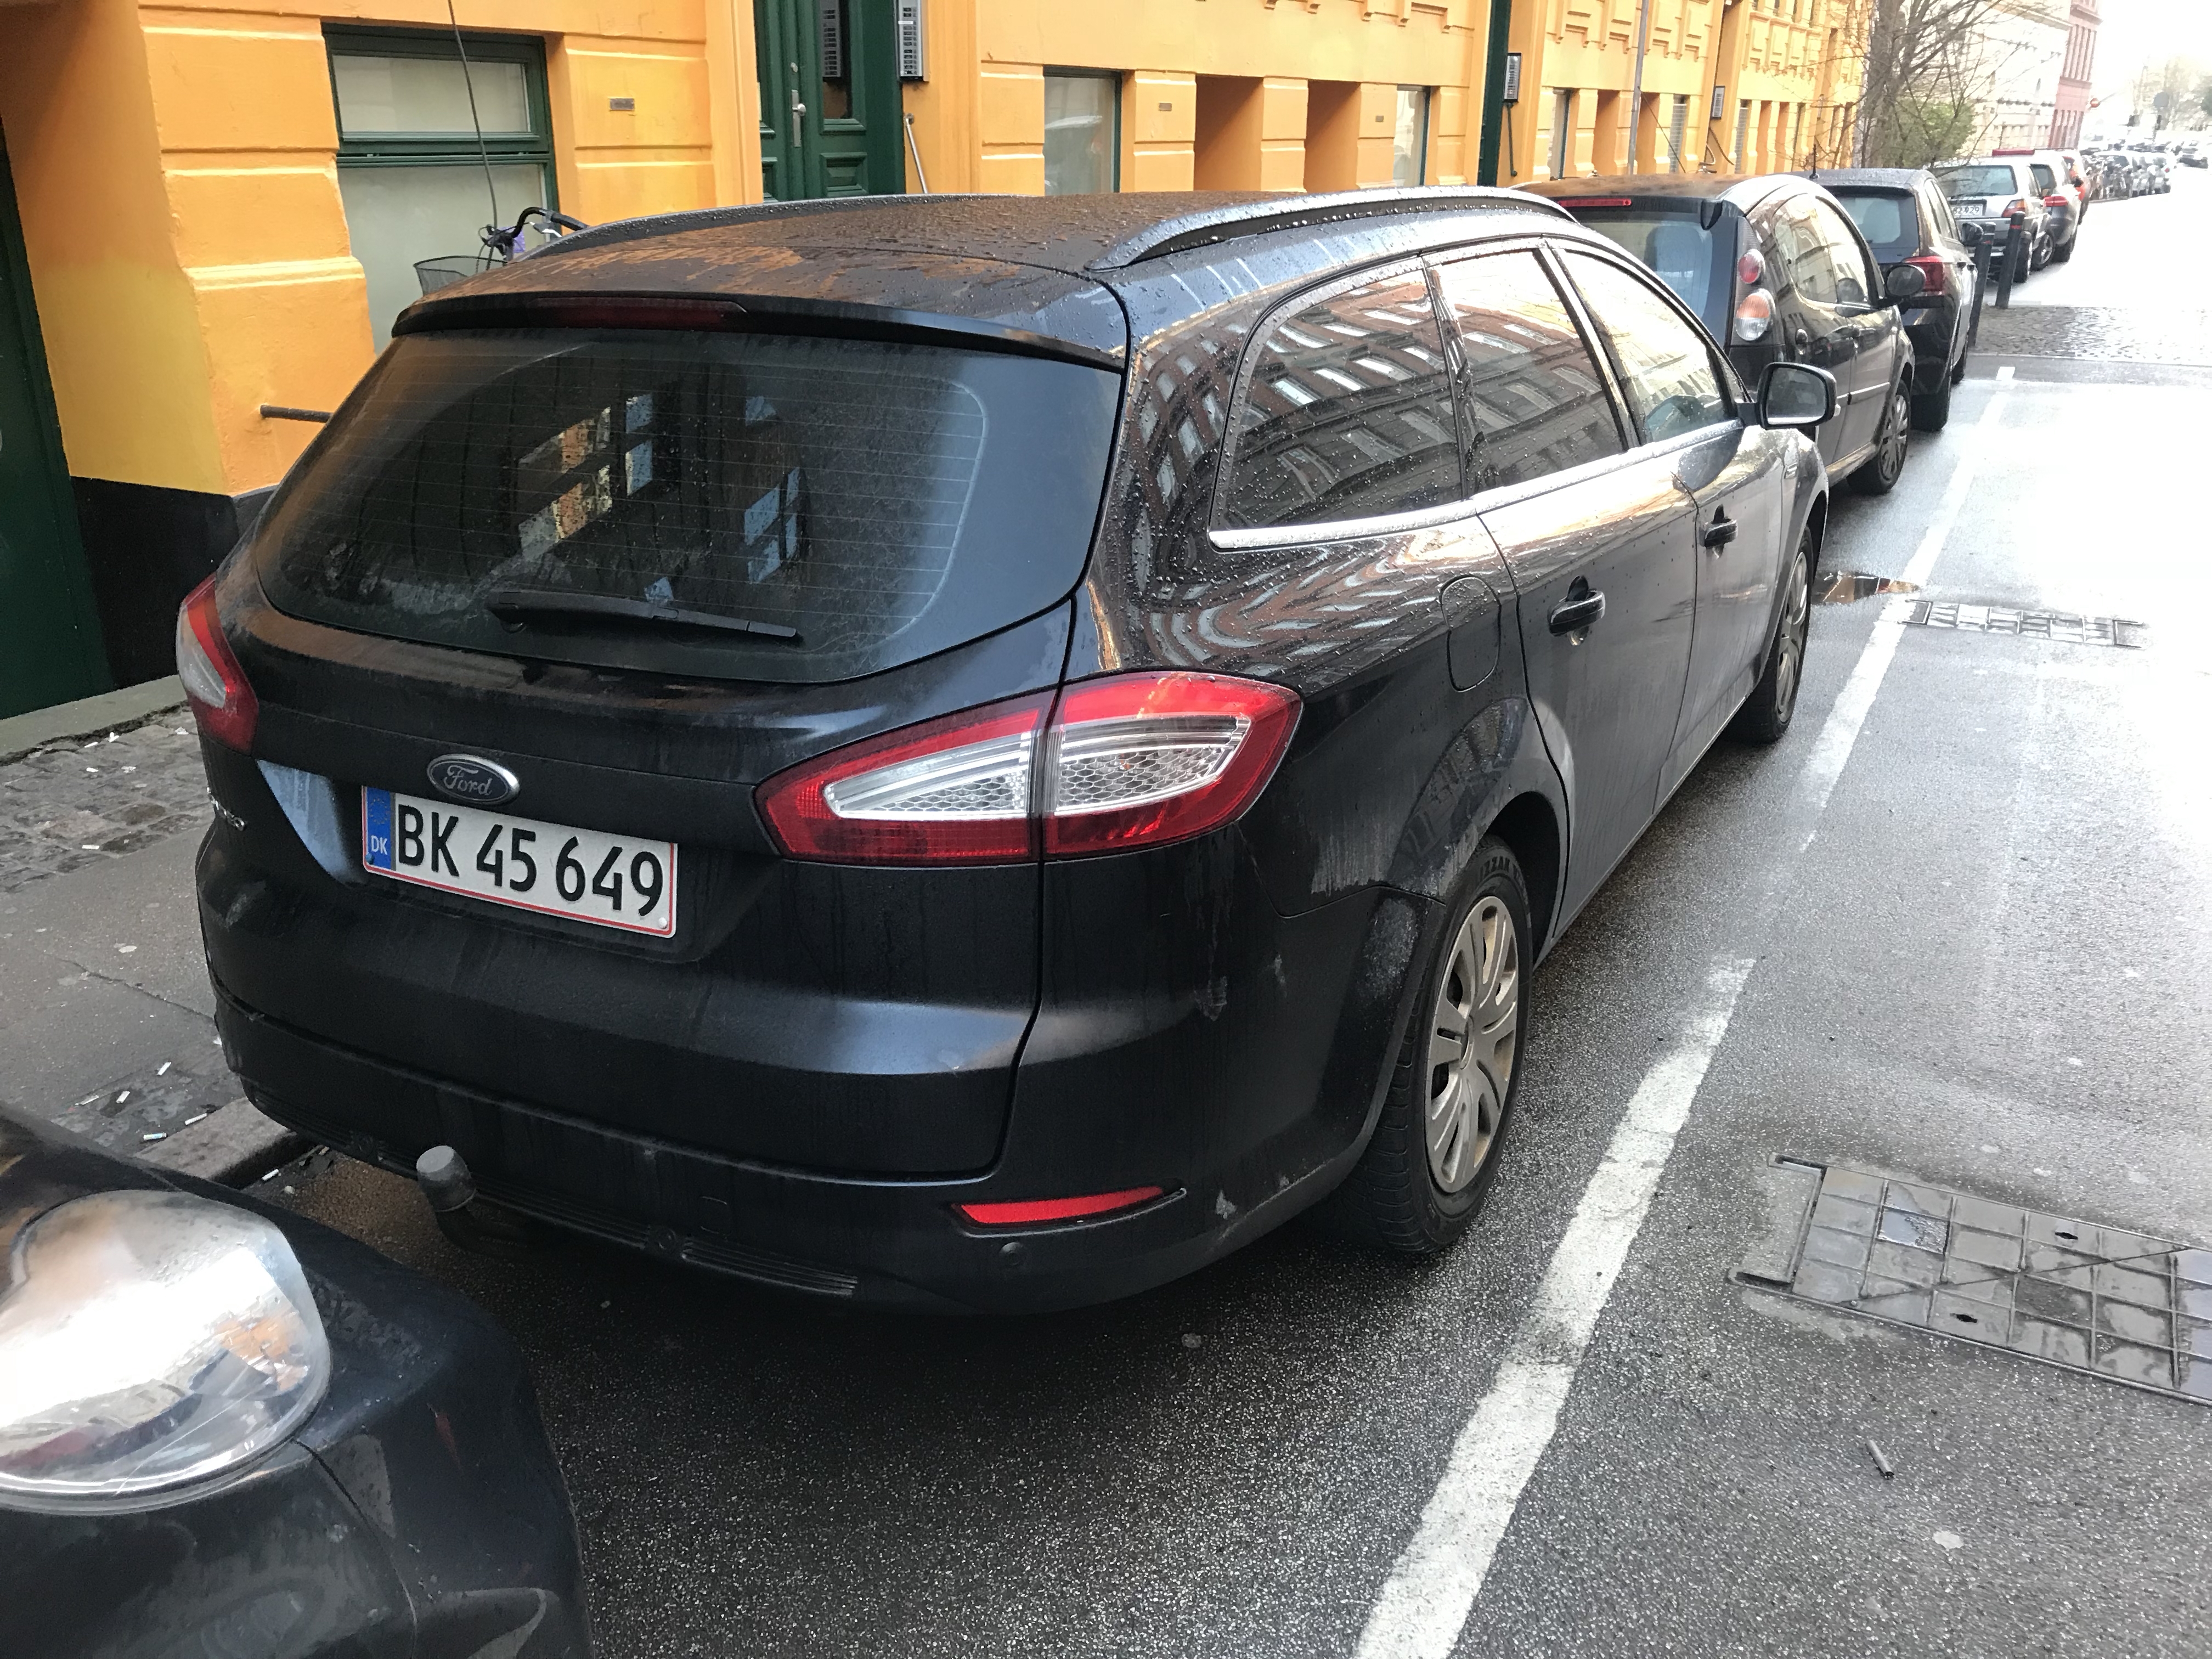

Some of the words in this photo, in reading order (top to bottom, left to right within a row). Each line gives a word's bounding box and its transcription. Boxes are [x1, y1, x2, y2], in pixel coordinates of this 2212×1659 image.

[443, 765, 493, 795] Ford
[371, 835, 388, 855] DK
[398, 804, 460, 877] BK
[476, 824, 537, 892] 45
[556, 836, 663, 917] 649
